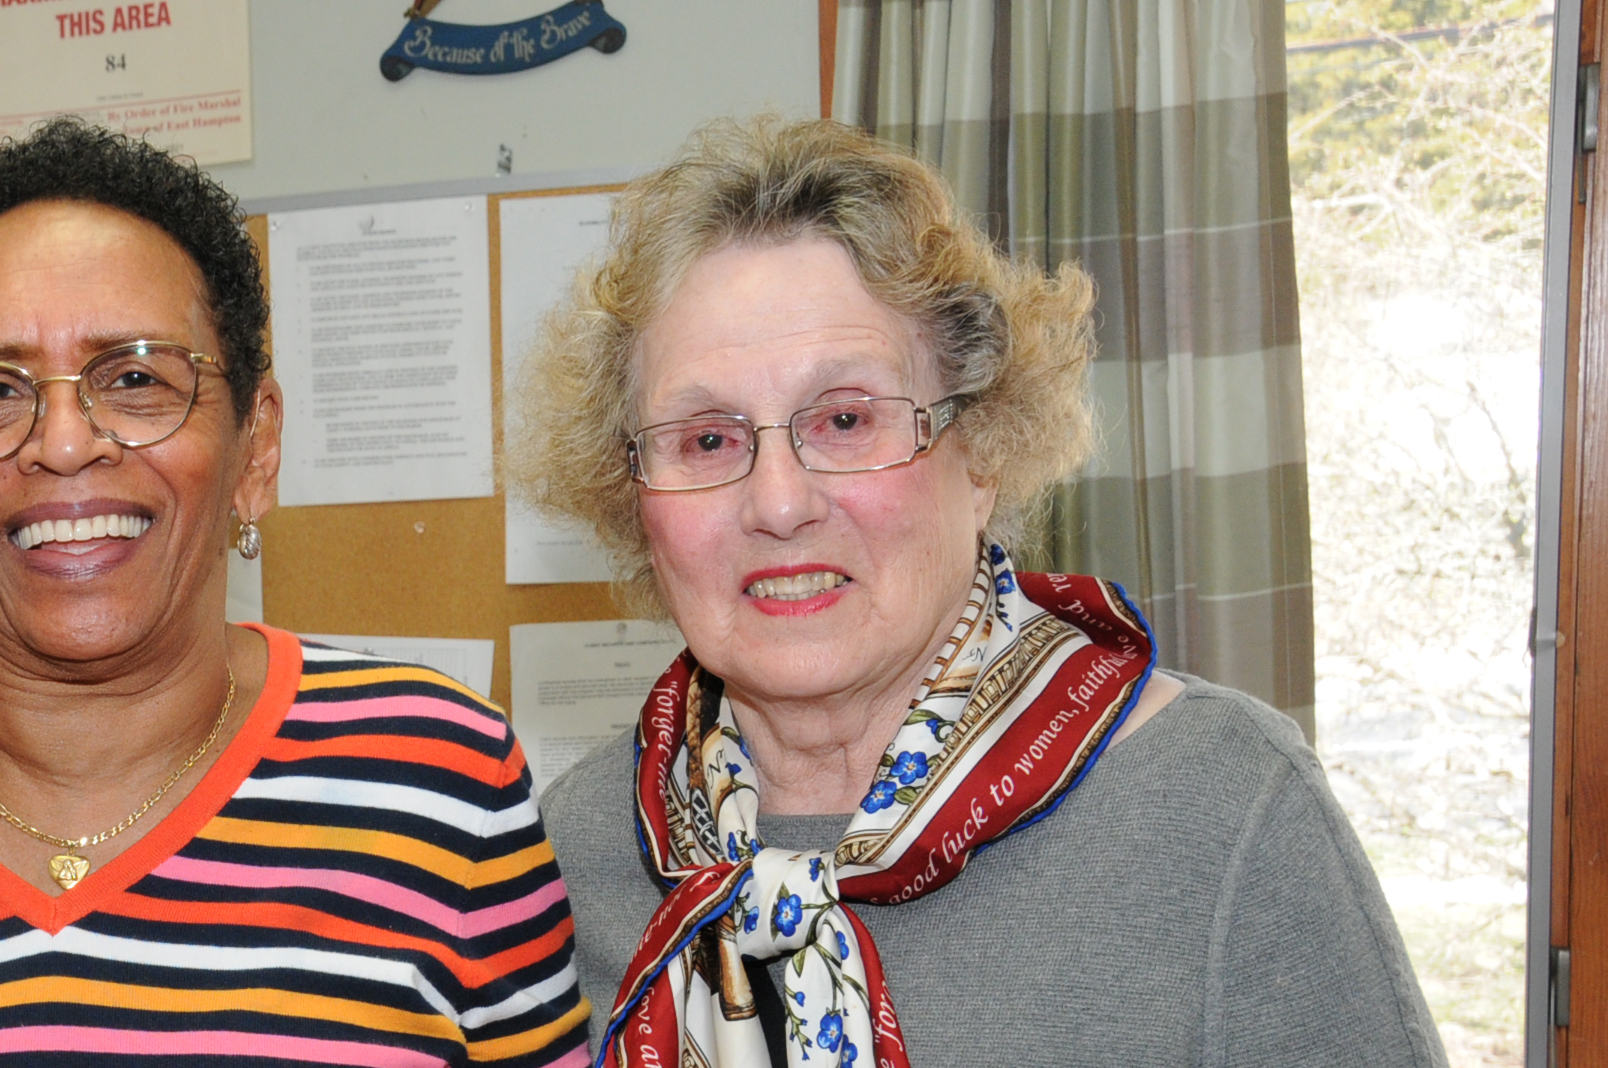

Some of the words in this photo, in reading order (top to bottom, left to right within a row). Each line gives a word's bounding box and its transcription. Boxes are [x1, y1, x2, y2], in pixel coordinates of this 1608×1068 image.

[56, 9, 105, 39] THIS
[112, 2, 171, 32] AREA
[404, 25, 485, 64] Because
[490, 30, 509, 62] of
[509, 28, 535, 62] the
[540, 14, 591, 49] Brave
[105, 53, 127, 72] 84
[107, 109, 121, 125] By
[124, 107, 157, 122] Order
[160, 104, 171, 116] of
[173, 101, 193, 115] Fire
[198, 97, 241, 111] Marshal
[153, 121, 165, 133] of
[167, 118, 190, 131] East
[193, 114, 241, 130] Hampton
[942, 797, 989, 864] luck
[989, 774, 1015, 807] to
[1012, 705, 1080, 776] women,
